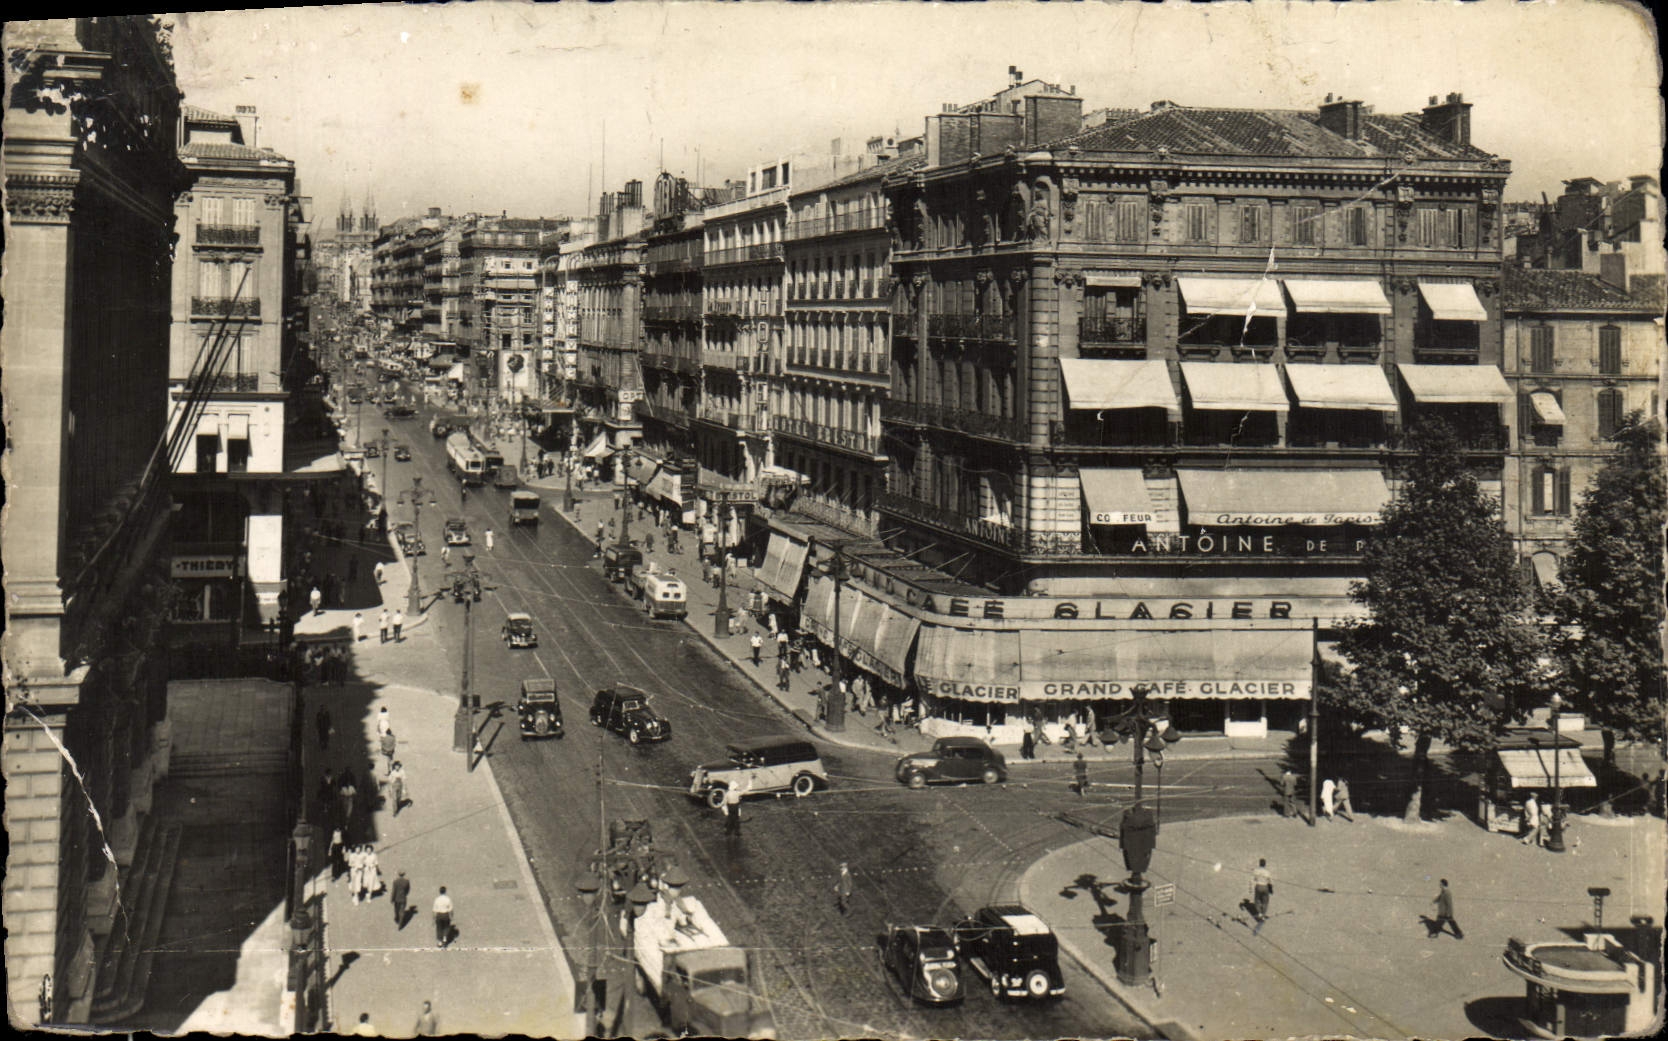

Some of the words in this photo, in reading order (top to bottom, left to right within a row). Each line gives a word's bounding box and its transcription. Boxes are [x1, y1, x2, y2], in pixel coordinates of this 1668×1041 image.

[1216, 513, 1294, 525] Antoine
[1302, 515, 1316, 524] de
[1131, 535, 1274, 552] ANTOINE
[1306, 540, 1328, 551] DE
[1053, 601, 1293, 620] GLACIER
[939, 682, 1019, 700] GLACIER
[1043, 683, 1123, 695] GRAND
[1200, 683, 1296, 695] GLACIER
